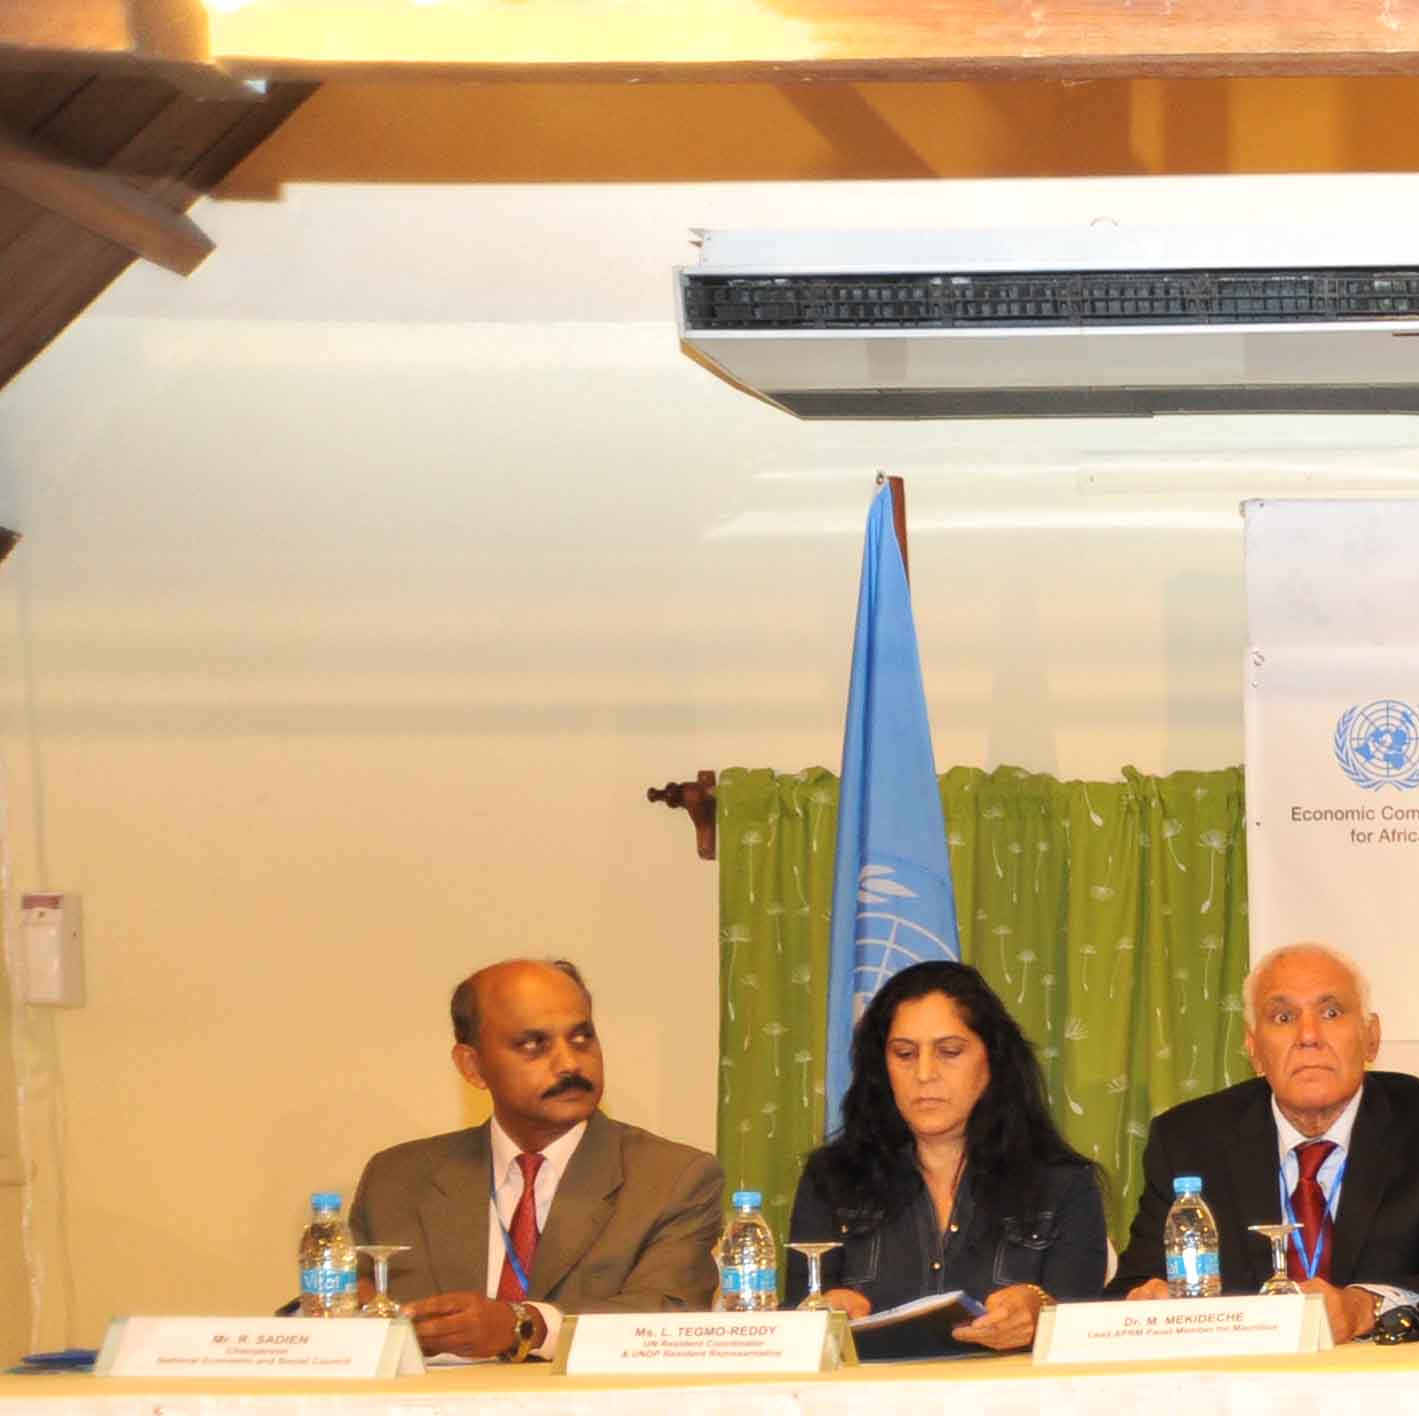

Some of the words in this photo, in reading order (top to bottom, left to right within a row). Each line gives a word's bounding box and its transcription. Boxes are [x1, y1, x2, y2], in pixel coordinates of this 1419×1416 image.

[1291, 805, 1375, 821] Economic
[1350, 827, 1373, 843] for
[1166, 1312, 1244, 1326] MEKIDECHE
[678, 1325, 777, 1338] TEGMO-REDDY
[256, 1334, 310, 1346] SADIEN
